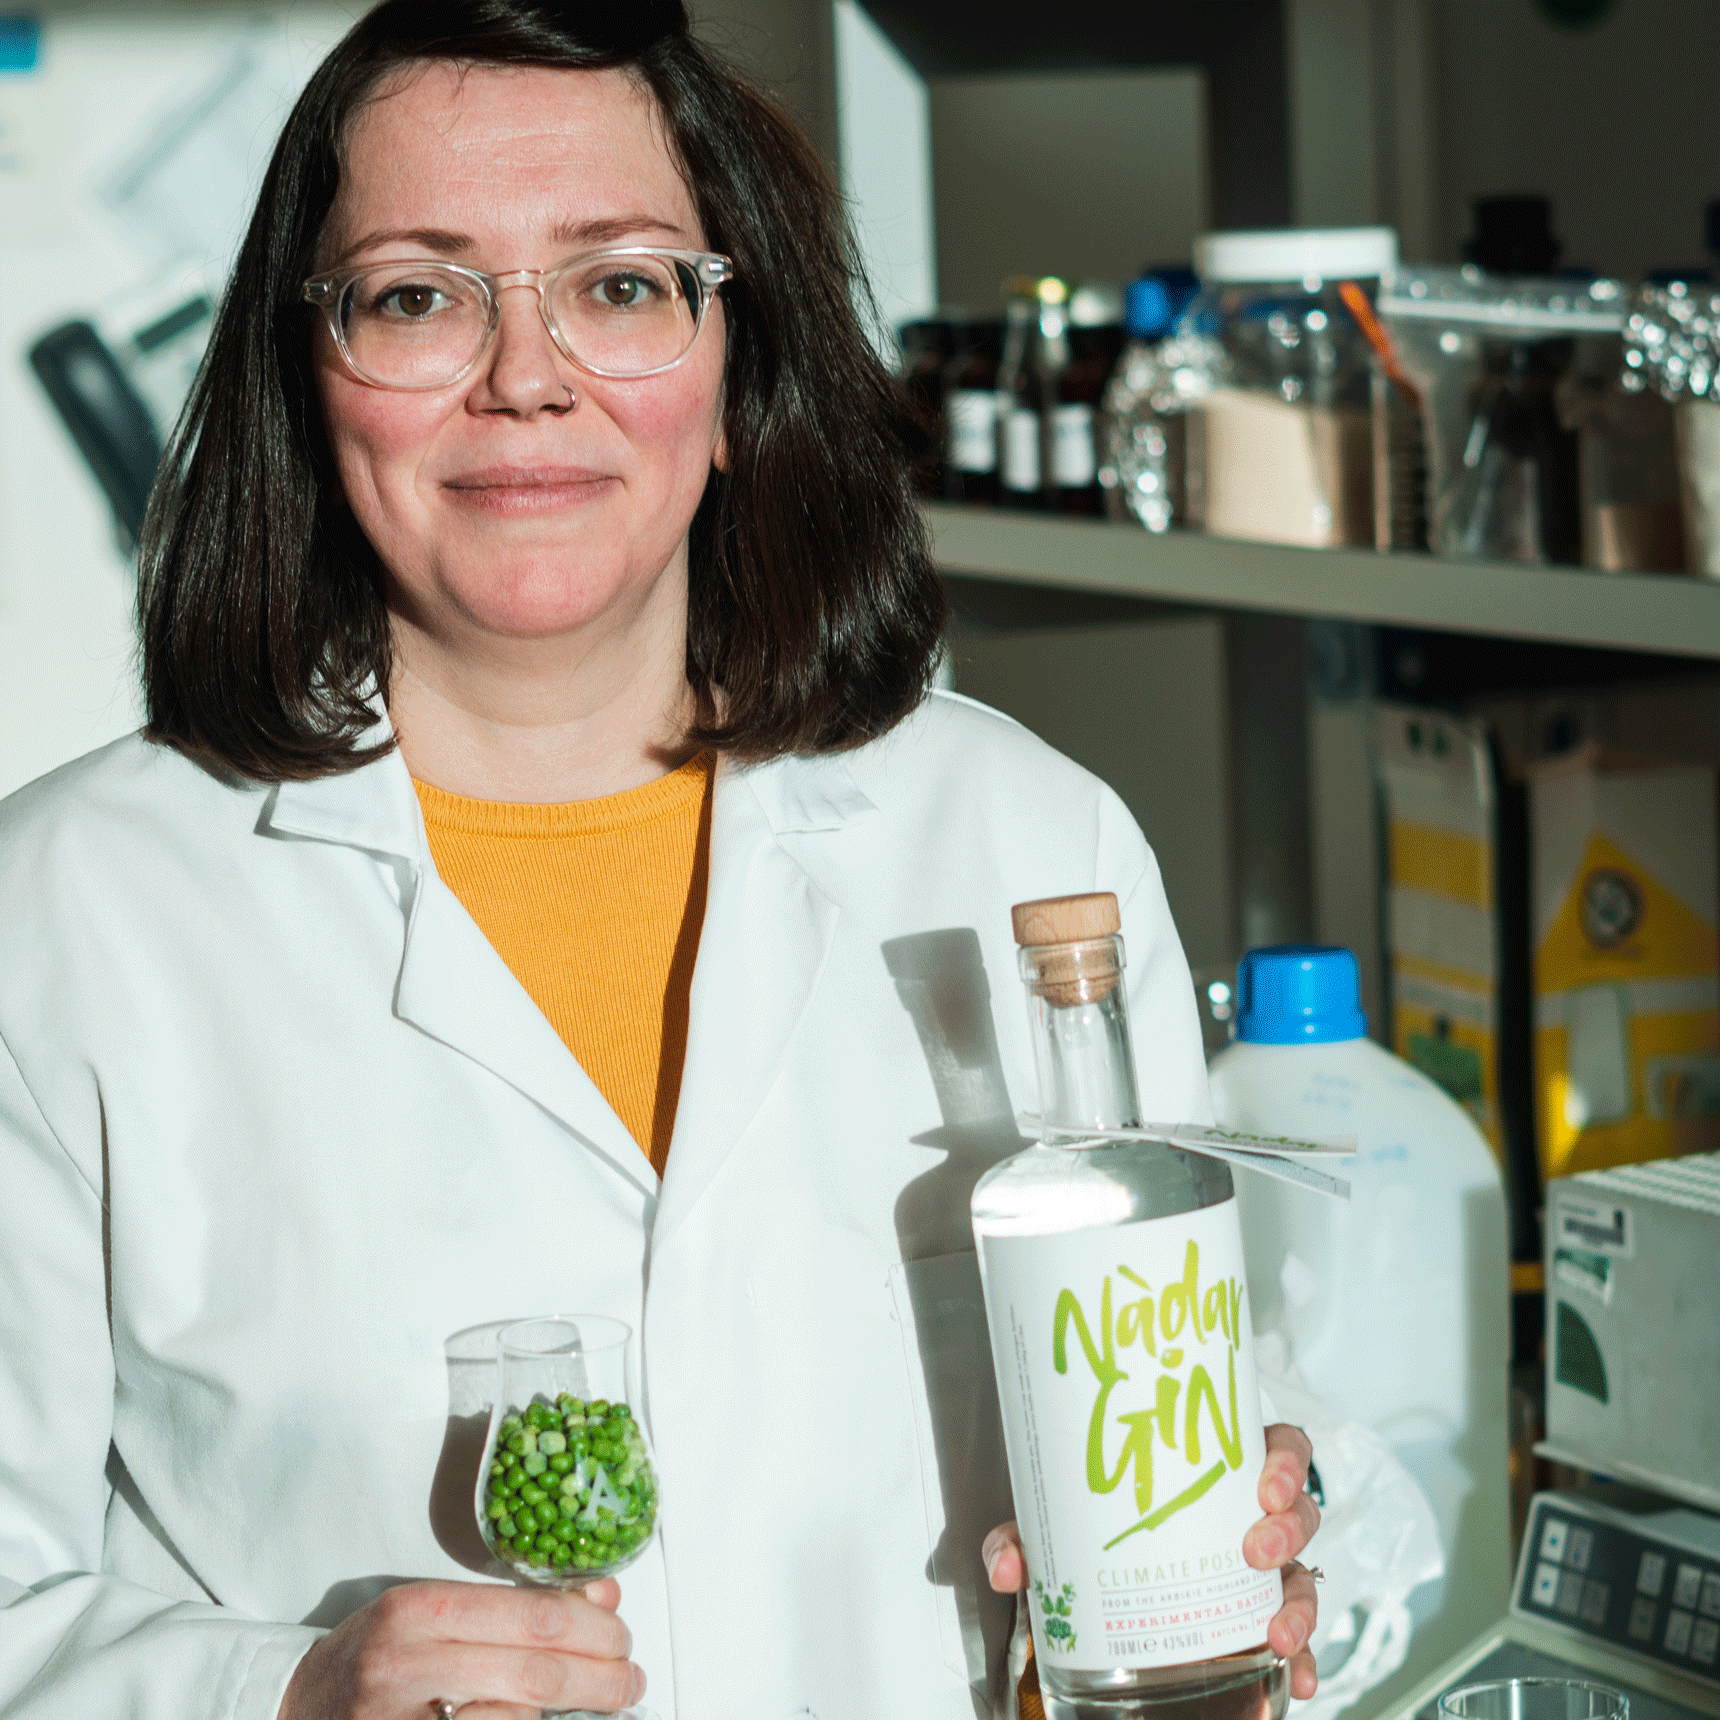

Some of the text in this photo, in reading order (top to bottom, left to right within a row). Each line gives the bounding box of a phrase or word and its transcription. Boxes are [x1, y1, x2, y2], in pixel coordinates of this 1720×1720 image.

[1097, 1549, 1240, 1587] CLIMATE POSI
[1102, 1597, 1130, 1608] FROM
[1136, 1595, 1155, 1605] THE
[1160, 1588, 1201, 1603] ARBIKIE
[1207, 1575, 1251, 1594] HIGHLAND
[1105, 1603, 1232, 1632] EXPERIMENTAL
[1211, 1627, 1236, 1639] BATCH
